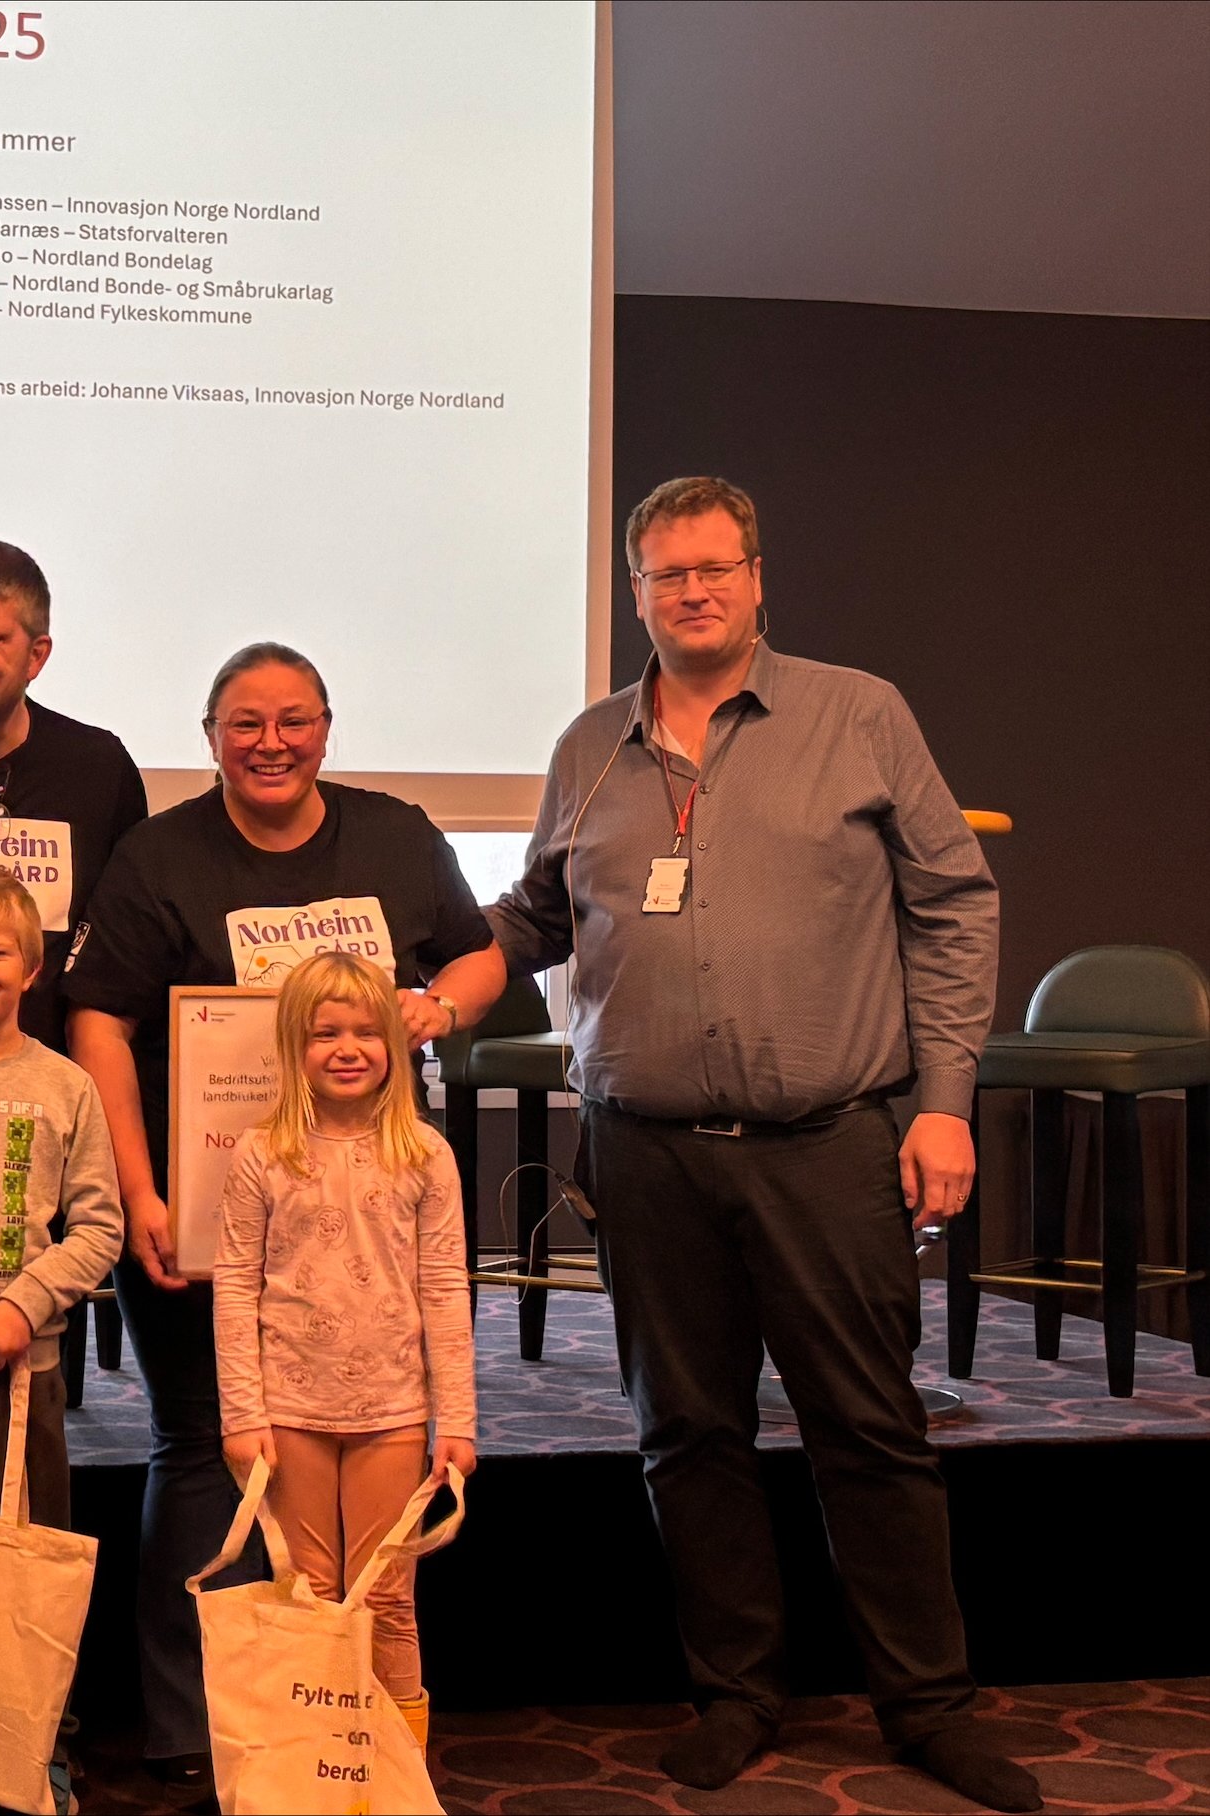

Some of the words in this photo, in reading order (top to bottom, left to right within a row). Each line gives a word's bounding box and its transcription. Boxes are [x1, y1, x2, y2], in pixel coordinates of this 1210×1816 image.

[67, 196, 169, 220] Innovasjon
[173, 200, 229, 223] Norge
[233, 202, 321, 222] Nordland
[78, 223, 228, 245] Statsforvalteren
[32, 248, 120, 268] Nordland
[124, 251, 214, 275] Bondelag
[12, 274, 100, 294] Nordland
[104, 277, 173, 296] Bonde-
[176, 282, 200, 301] og
[202, 279, 335, 305] Småbrukarlag
[8, 300, 95, 320] Nordland
[100, 303, 253, 325] Fylkeskommune
[20, 380, 86, 398] arbeid:
[90, 381, 168, 401] Johanne
[171, 384, 250, 406] Viksaas,
[255, 386, 355, 409] Innovasjon
[360, 389, 415, 411] Norge
[419, 391, 505, 409] Nordland
[12, 861, 60, 883] ÅRD
[237, 909, 374, 947] Norheim
[12, 1101, 32, 1115] OF
[291, 1682, 335, 1708] Fylt
